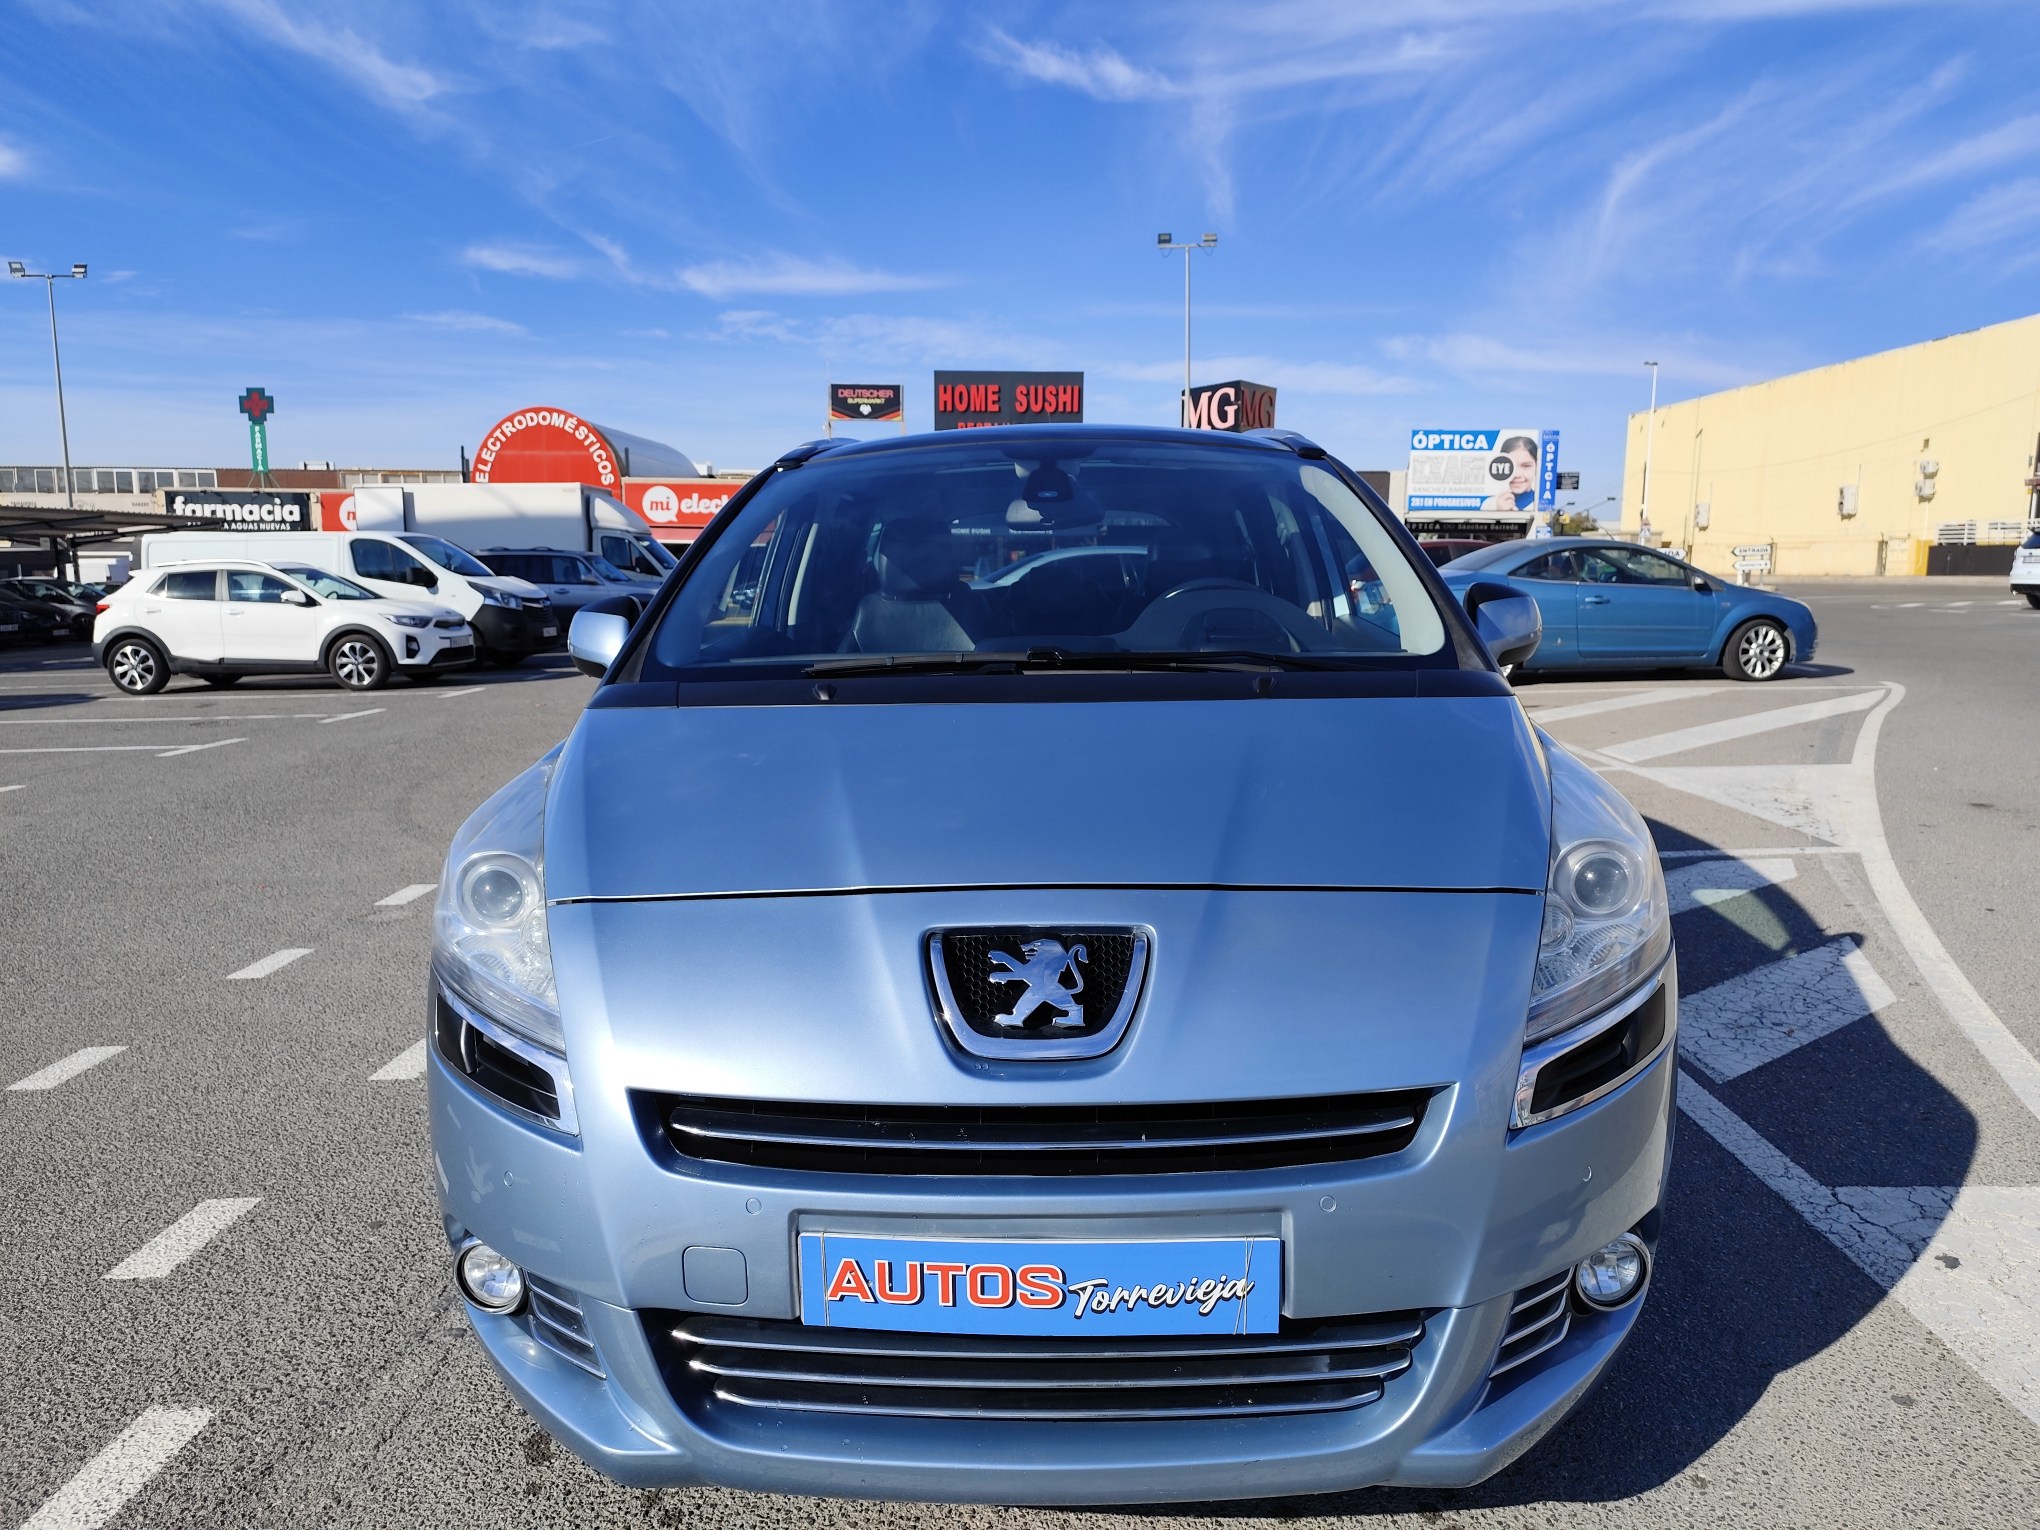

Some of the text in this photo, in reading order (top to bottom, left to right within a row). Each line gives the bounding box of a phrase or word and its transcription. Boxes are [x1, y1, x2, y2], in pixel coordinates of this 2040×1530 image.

[837, 388, 894, 398] DEUTSCHER
[938, 384, 1080, 413] HOME SUSHI
[1182, 387, 1238, 430] MG
[1241, 388, 1274, 428] MG
[254, 425, 264, 471] FARMACIA
[475, 411, 615, 486] ELECTRODOMÉSTICOS
[1412, 431, 1489, 450] ÓPTICA
[1491, 462, 1511, 475] EYE
[173, 495, 301, 522] farmacia
[650, 496, 673, 511] mi
[230, 522, 259, 530] AGUAS
[259, 522, 291, 531] NUEVAS
[828, 1257, 1255, 1319] AUTOS Torrevieja
